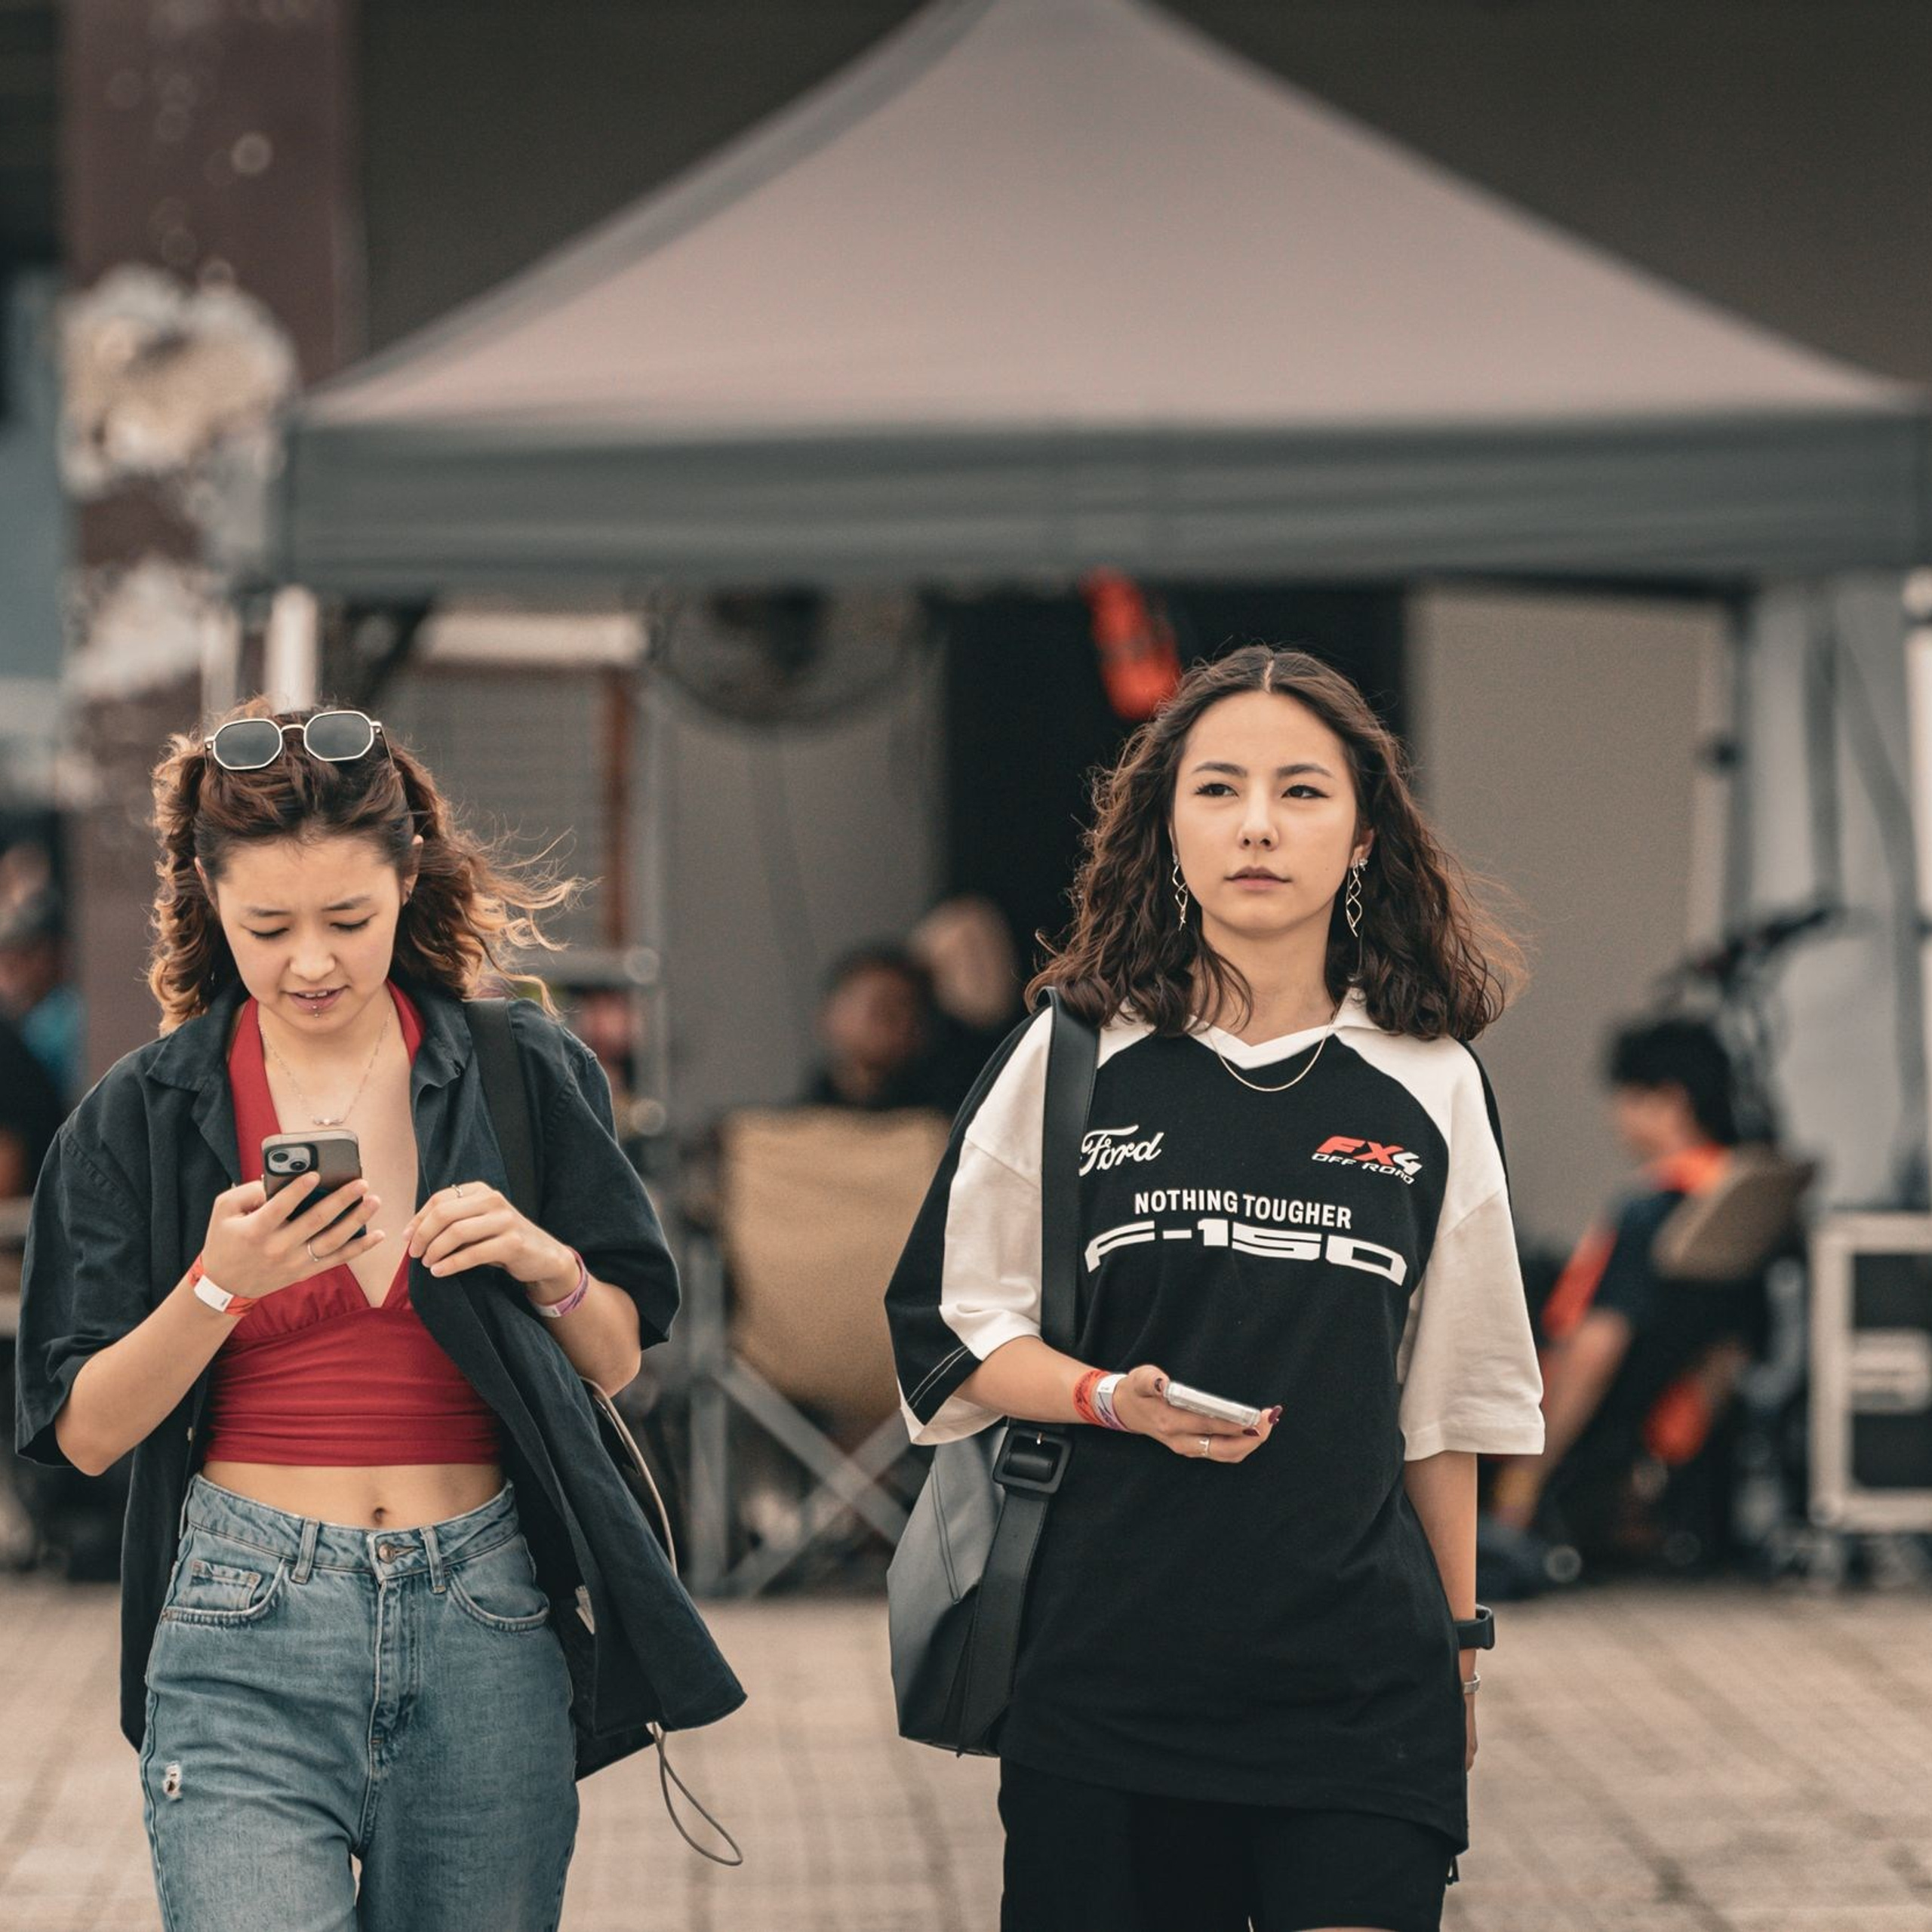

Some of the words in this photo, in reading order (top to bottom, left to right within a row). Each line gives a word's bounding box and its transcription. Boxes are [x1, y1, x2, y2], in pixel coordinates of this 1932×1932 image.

[1078, 1124, 1164, 1177] Ford
[1311, 1152, 1358, 1165] OFF
[1361, 1162, 1415, 1185] ROAD
[1315, 1135, 1423, 1176] FX4
[1134, 1189, 1238, 1215] NOTHING
[1242, 1194, 1352, 1229] TOUGHER
[1084, 1218, 1407, 1286] F-150
